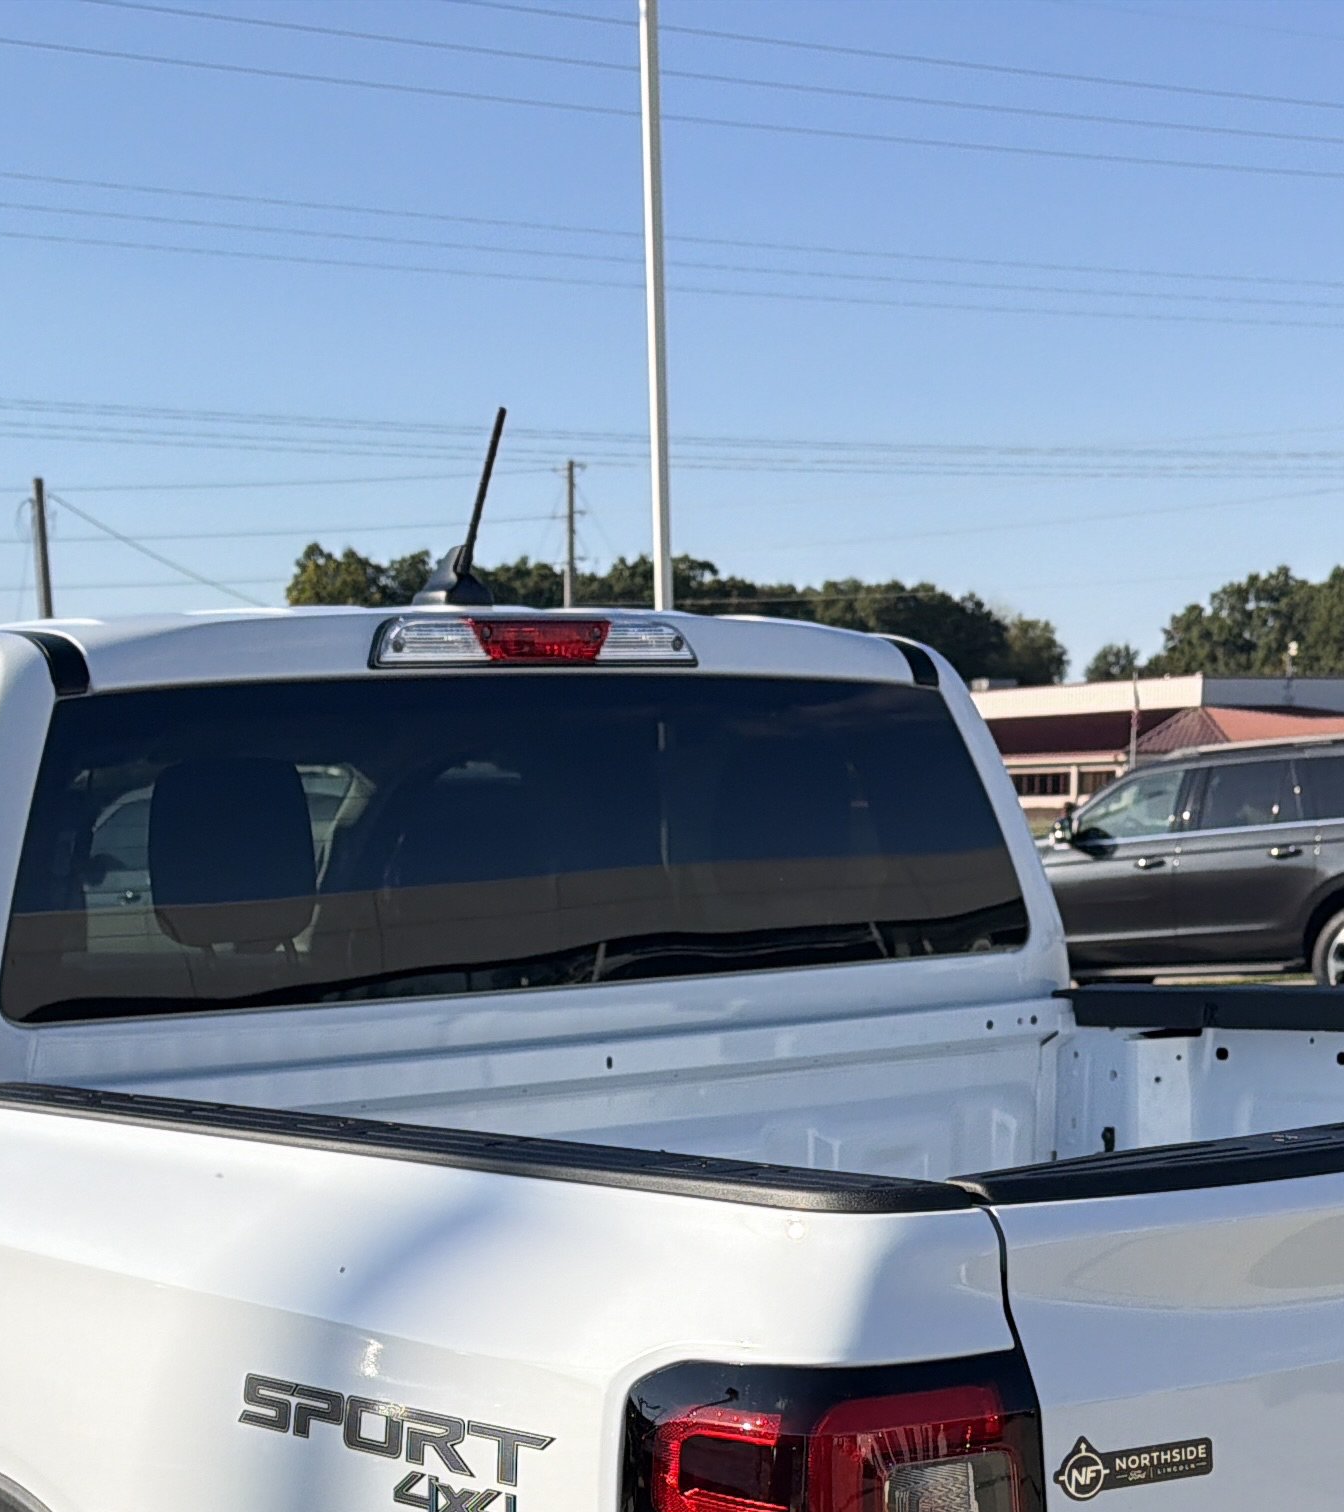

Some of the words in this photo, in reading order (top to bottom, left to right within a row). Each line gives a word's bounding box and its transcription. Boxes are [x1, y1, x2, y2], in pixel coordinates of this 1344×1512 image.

[238, 1373, 557, 1487] SPORT
[1115, 1444, 1207, 1471] NORTHSIDE
[1157, 1463, 1196, 1475] LINCOLN
[1071, 1465, 1103, 1493] NF
[1127, 1469, 1148, 1482] Ford
